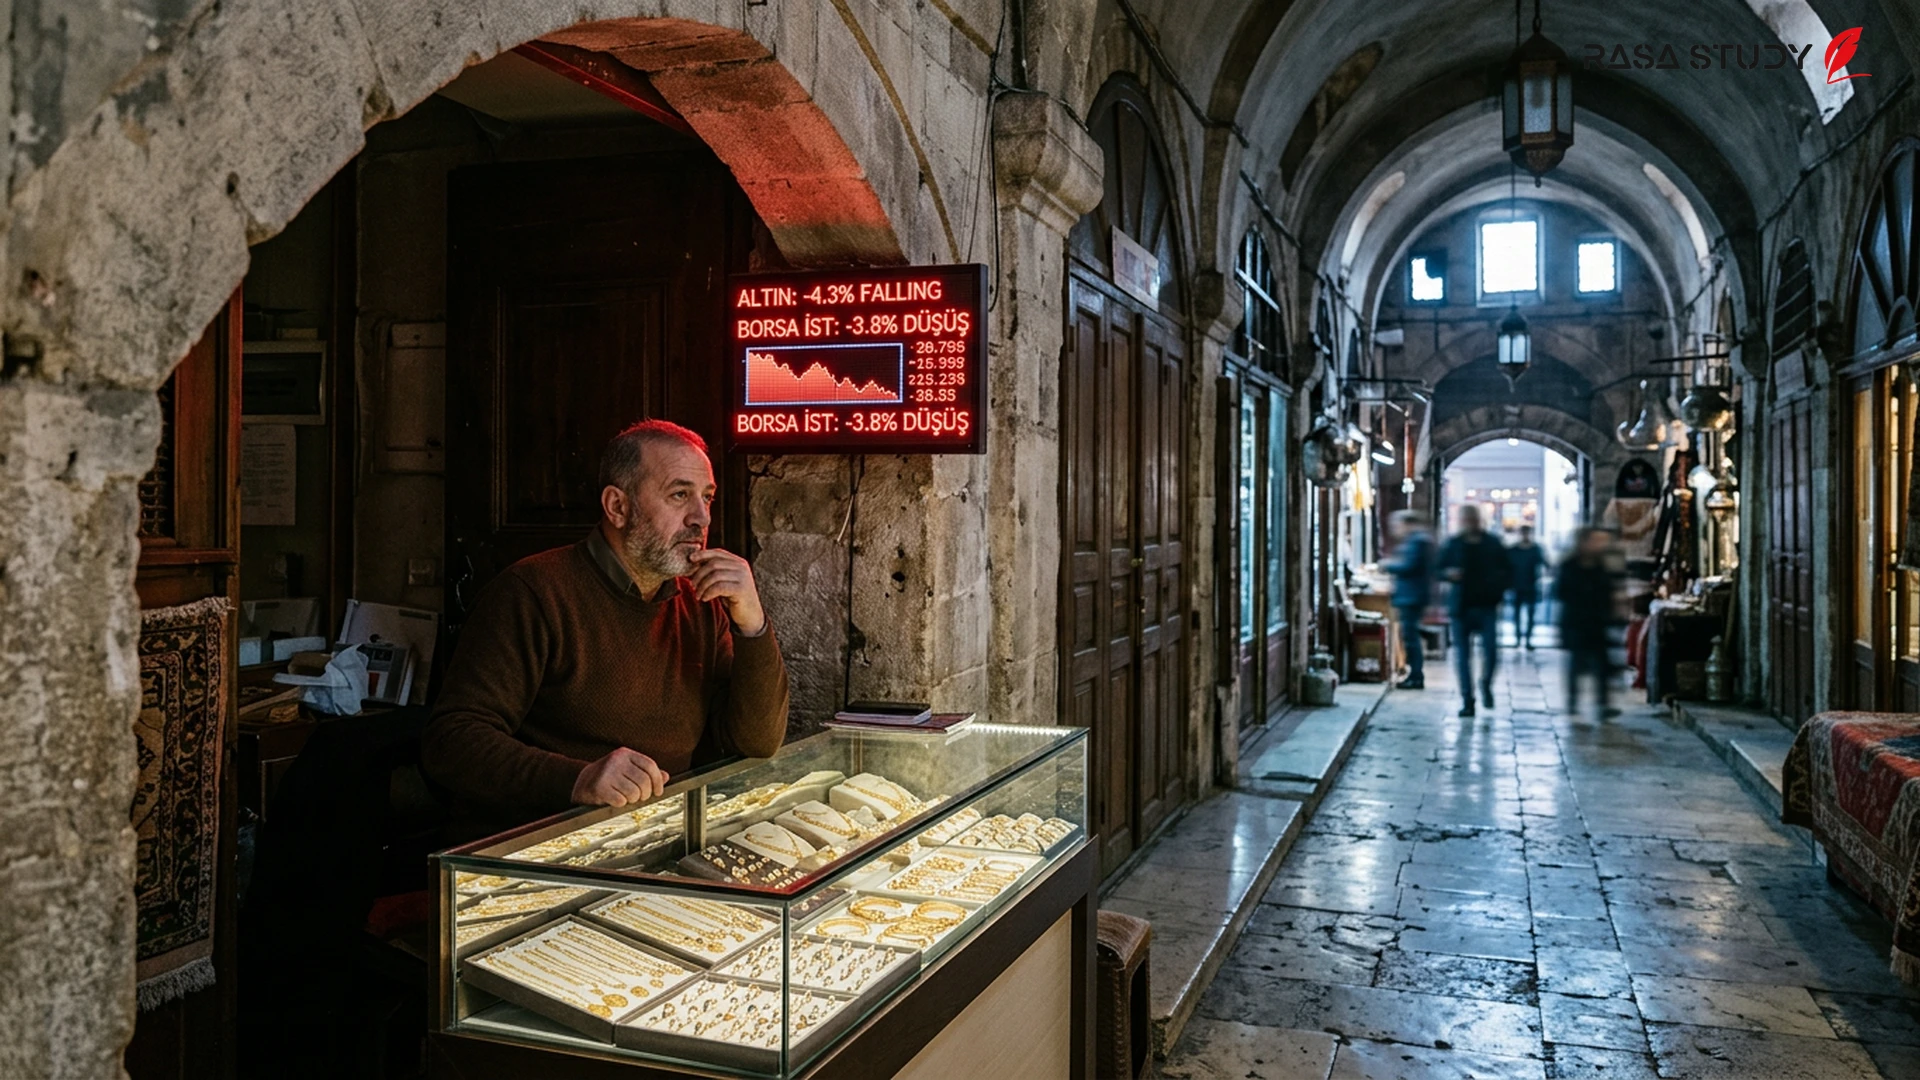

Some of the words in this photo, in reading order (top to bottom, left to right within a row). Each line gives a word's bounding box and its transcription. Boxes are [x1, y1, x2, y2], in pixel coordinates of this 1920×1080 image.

[737, 287, 797, 308] ALTIN:
[803, 284, 855, 304] -4.3%
[860, 280, 942, 302] FALLING
[738, 318, 799, 339] BORSA
[805, 313, 839, 336] İST:
[846, 315, 898, 335] -3.8%
[904, 309, 969, 336] DÜŞÜŞ
[737, 413, 798, 432] BORSA
[804, 409, 839, 432] İST:
[845, 412, 897, 431] -3.8%
[903, 408, 969, 436] DÜŞÜŞ
